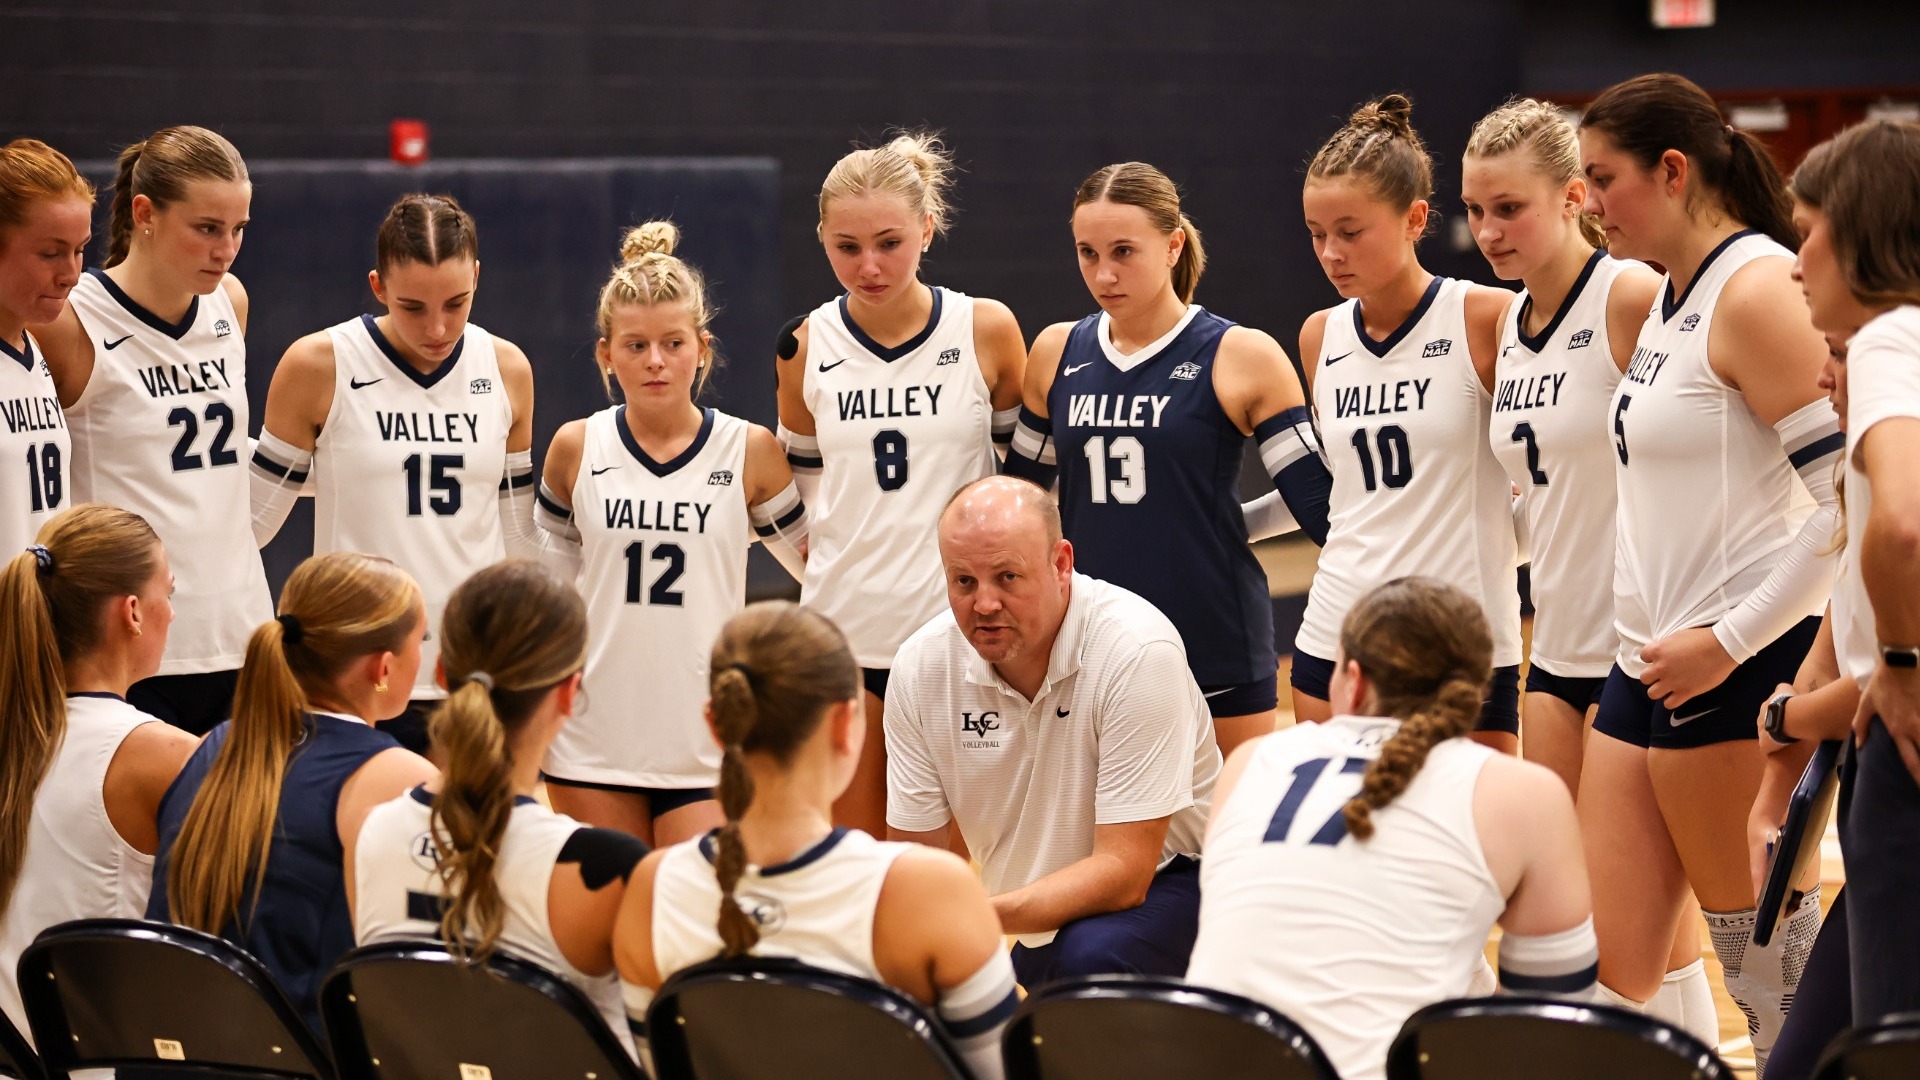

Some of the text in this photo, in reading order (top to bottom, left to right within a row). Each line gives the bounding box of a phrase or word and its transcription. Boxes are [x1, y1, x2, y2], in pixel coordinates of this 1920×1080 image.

[138, 358, 232, 398] VALLEY
[1336, 377, 1431, 419] VALLEY
[1495, 372, 1567, 413] VALLEY
[0, 397, 63, 433] VALLEY
[838, 384, 942, 421] VALLEY
[1068, 394, 1171, 428] VALLEY
[167, 402, 238, 474] 22
[376, 410, 478, 443] VALLEY
[1614, 392, 1633, 469] 5
[26, 441, 63, 513] 18
[871, 427, 909, 493] 8
[1084, 435, 1147, 504] 13
[1351, 423, 1414, 493] 10
[402, 452, 466, 518] 15
[605, 498, 712, 534] VALLEY
[623, 540, 687, 608] 12
[961, 741, 1000, 749] VOLLEYBALL
